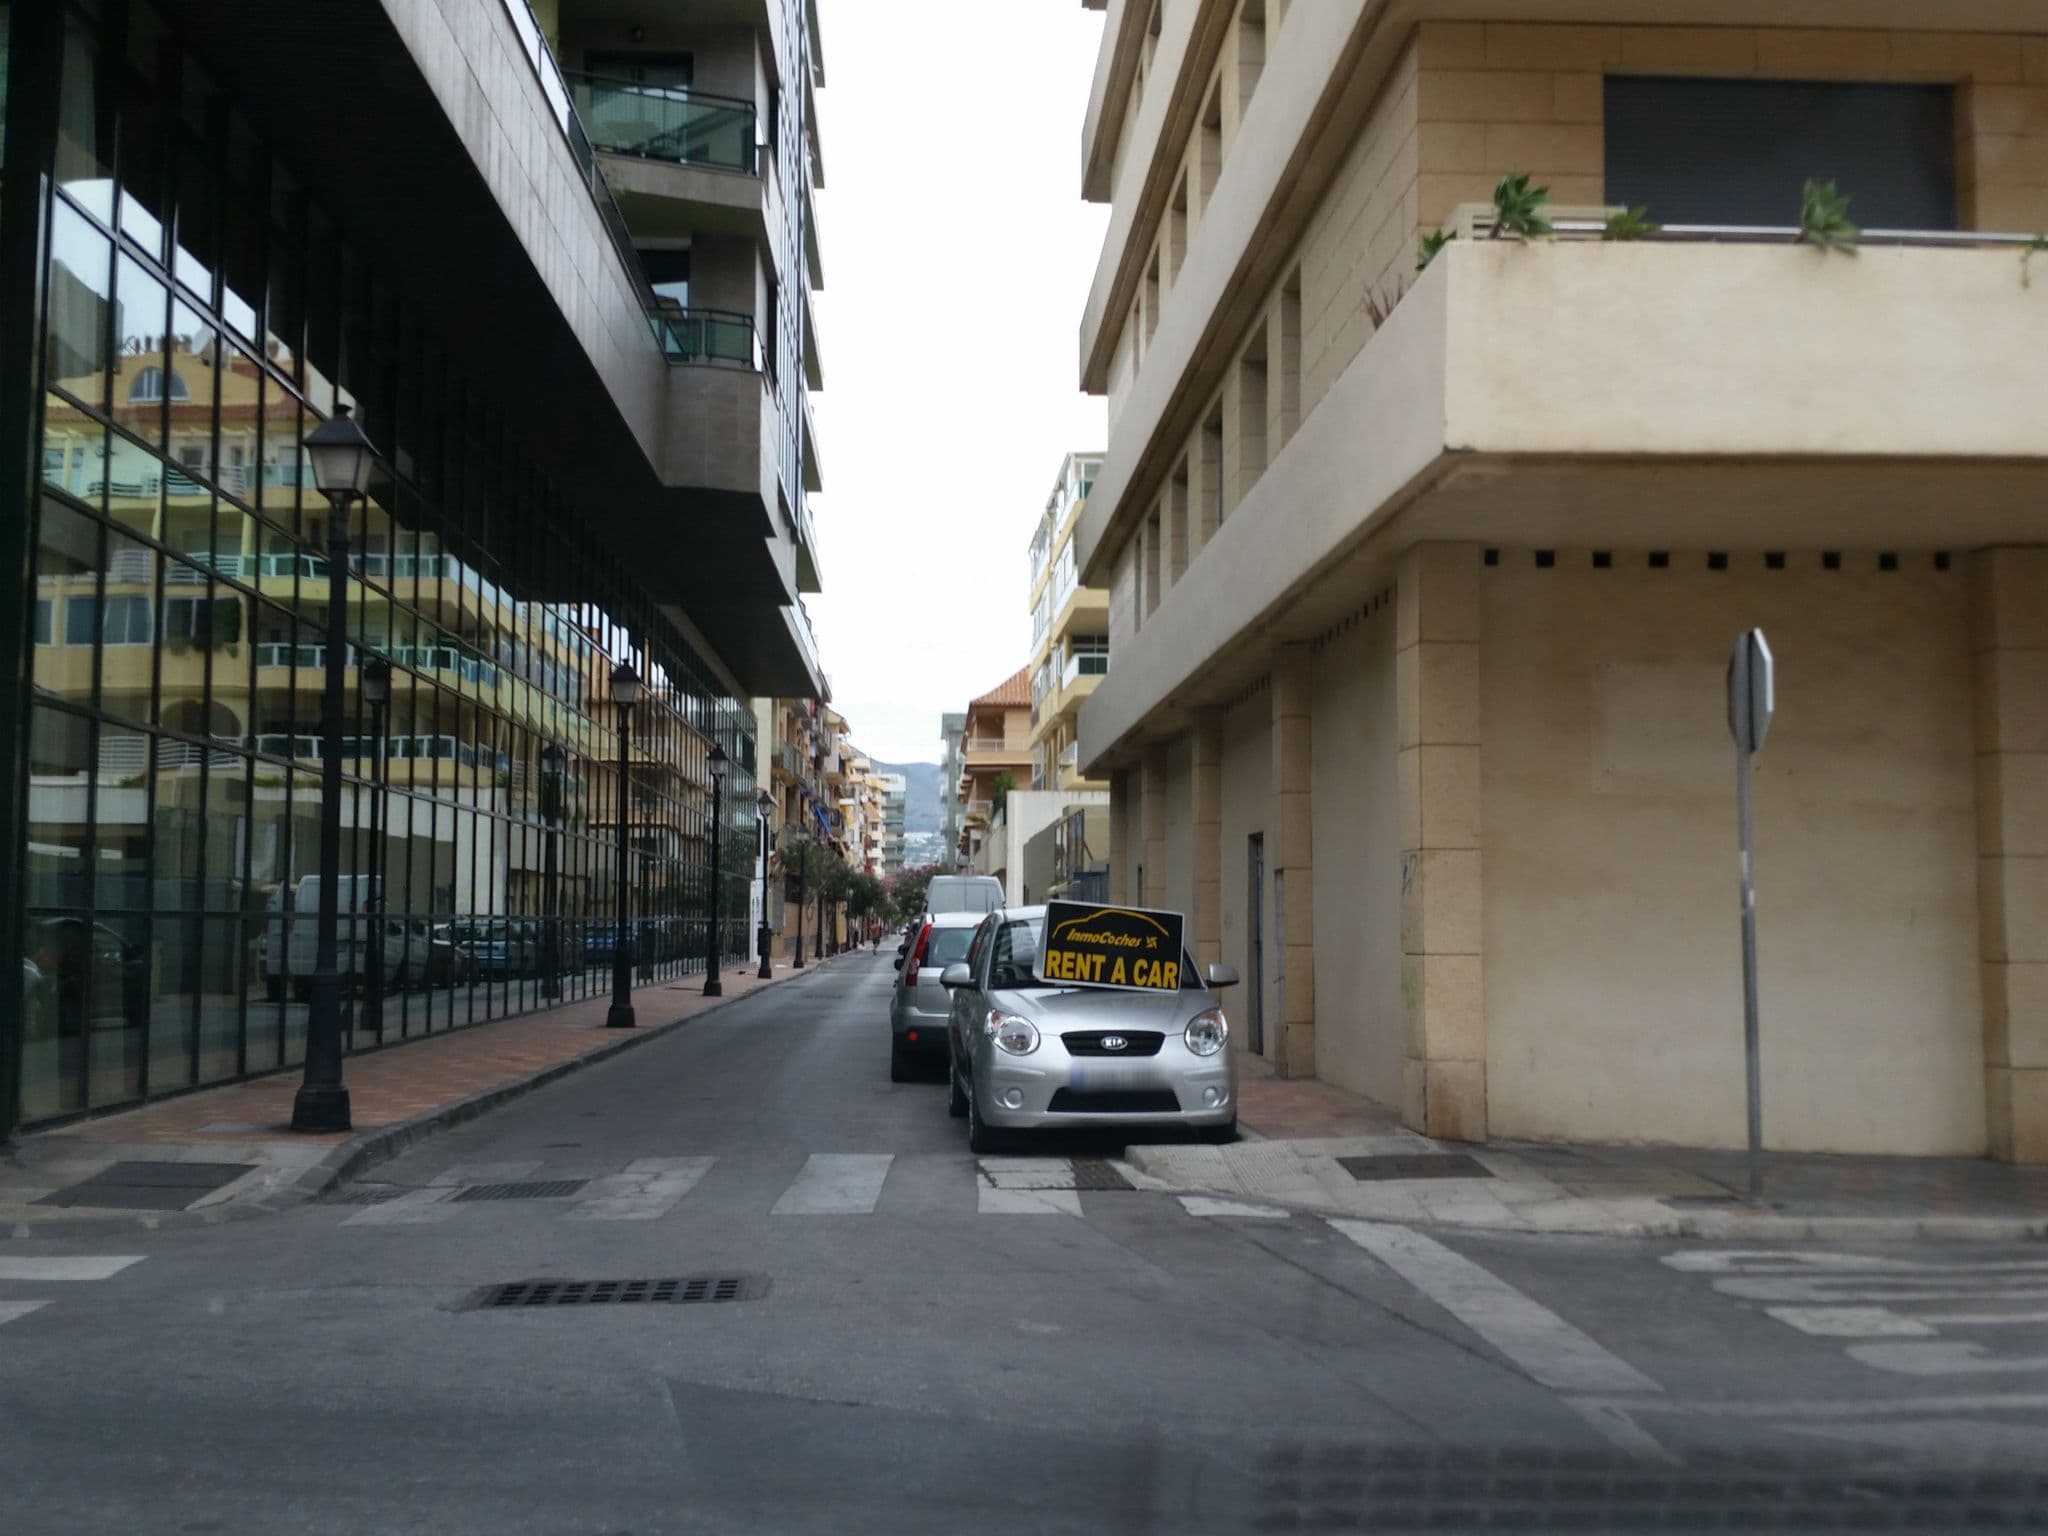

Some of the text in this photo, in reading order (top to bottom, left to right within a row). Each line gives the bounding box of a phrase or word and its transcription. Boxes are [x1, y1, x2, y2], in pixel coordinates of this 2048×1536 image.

[1067, 928, 1142, 948] InmoCoches
[1046, 949, 1178, 989] RENT A CAR
